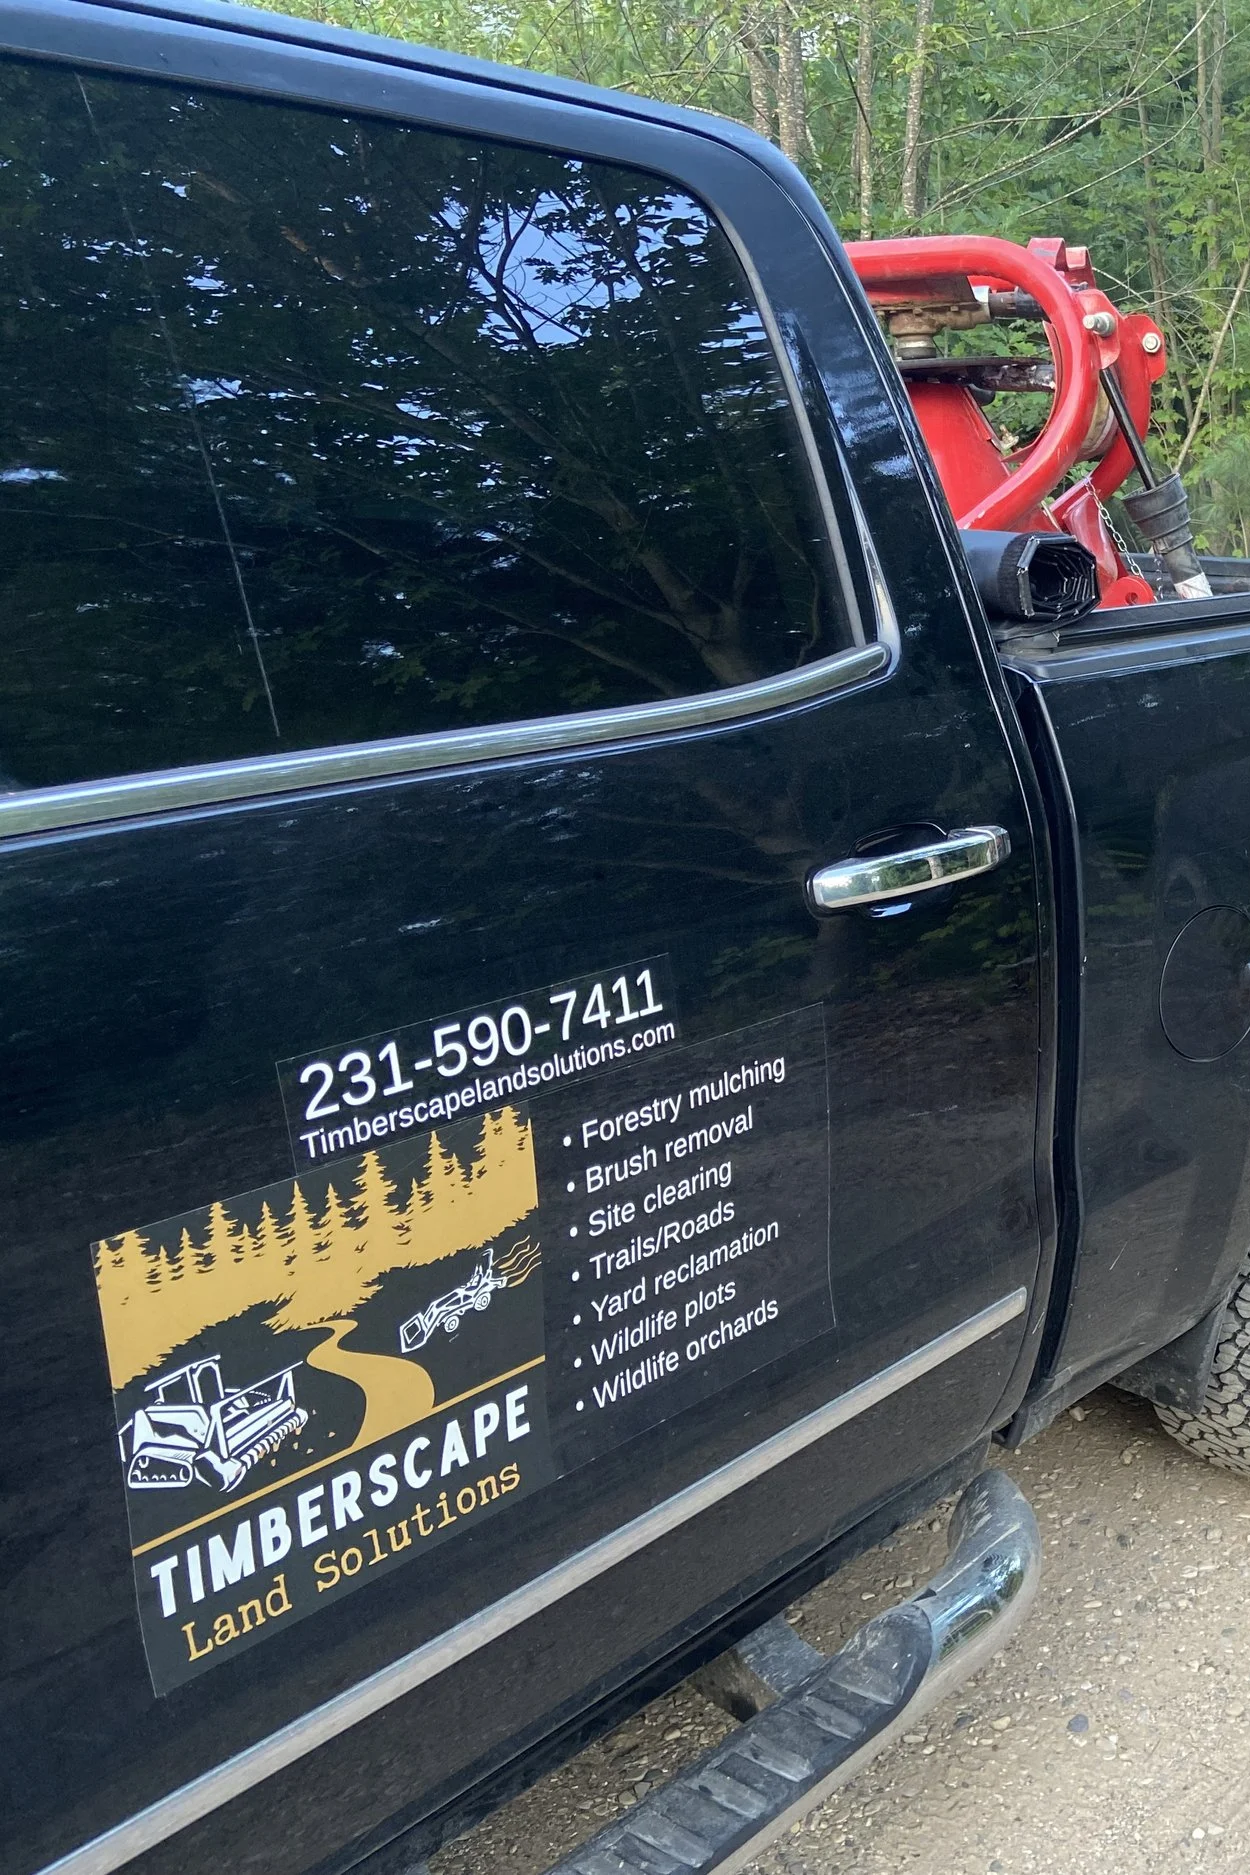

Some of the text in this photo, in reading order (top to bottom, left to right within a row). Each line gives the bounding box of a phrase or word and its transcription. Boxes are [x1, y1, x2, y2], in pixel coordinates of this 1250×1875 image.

[299, 968, 664, 1121] 231-590-7411
[299, 1021, 676, 1159] Timberscapelandsolutions.com
[581, 1056, 786, 1149] Forestry mulching
[586, 1104, 754, 1194] Brush removal
[588, 1160, 733, 1237] Site clearing
[589, 1200, 736, 1280] Trails/Roads
[591, 1221, 780, 1322] Yard reclamation
[591, 1281, 737, 1366] Wildlife plots
[592, 1299, 780, 1409] Wildlife orchards
[150, 1384, 532, 1619] TIMBERSCAPE
[181, 1462, 522, 1662] Land Solutions
